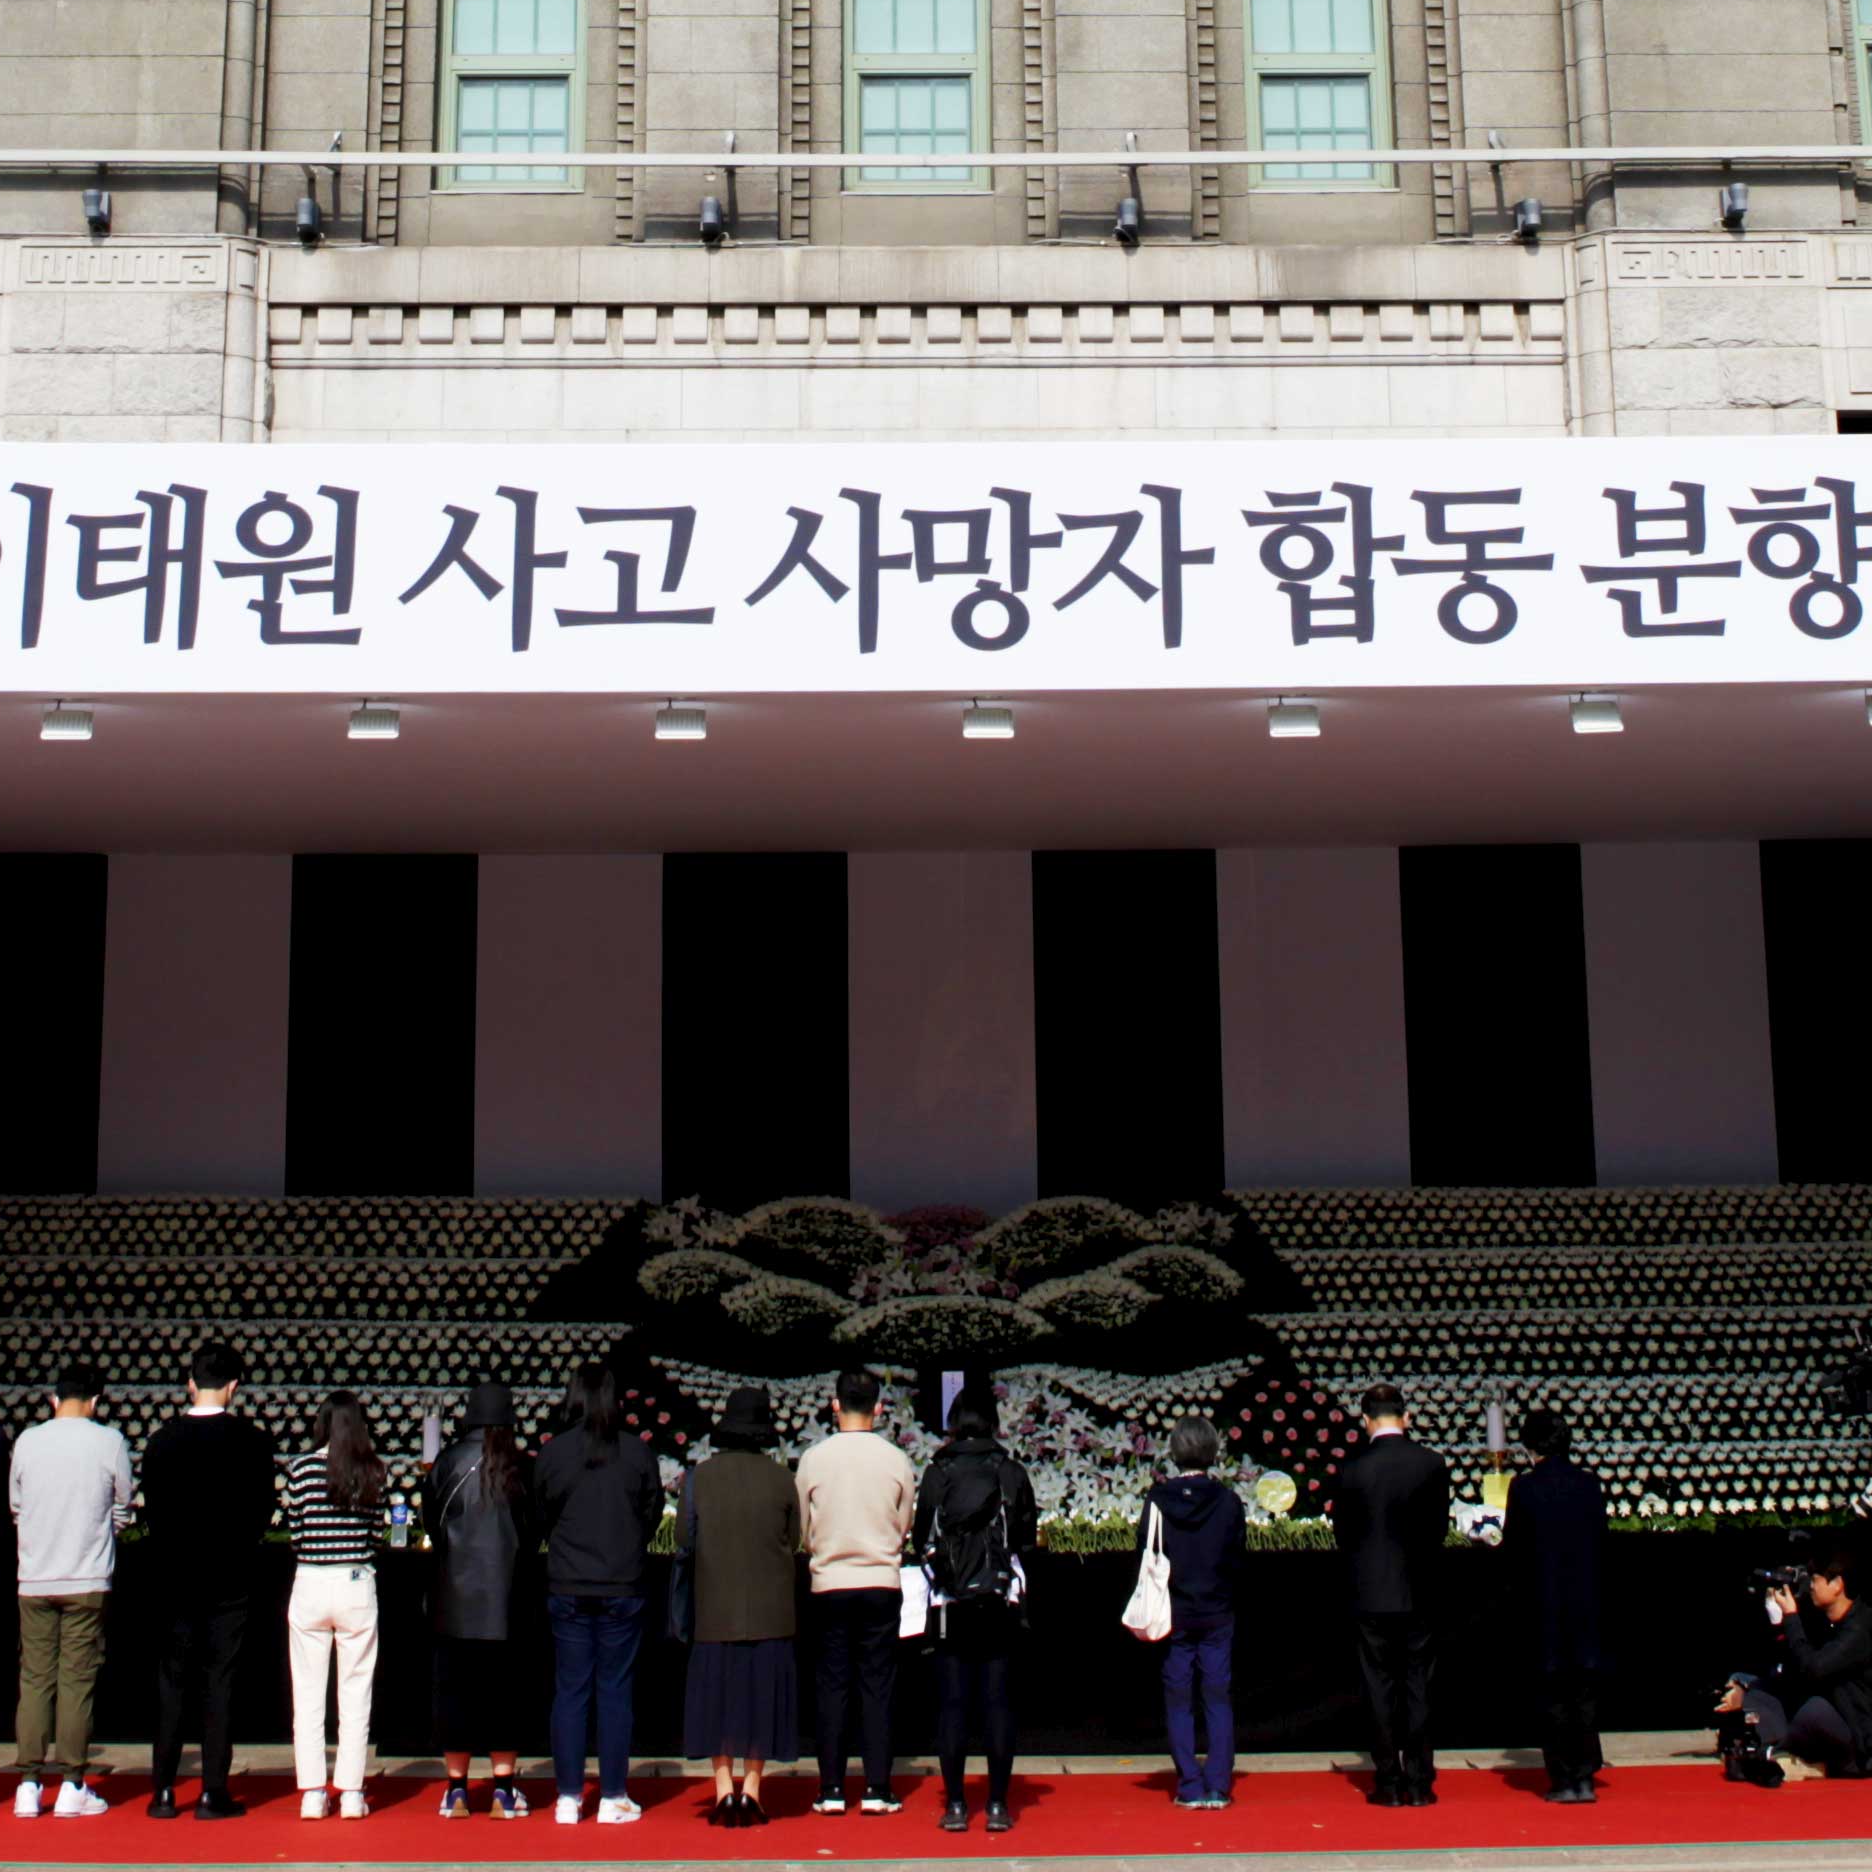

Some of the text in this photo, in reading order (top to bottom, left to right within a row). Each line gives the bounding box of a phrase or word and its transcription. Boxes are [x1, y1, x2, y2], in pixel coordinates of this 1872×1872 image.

[399, 486, 714, 653] 사고
[745, 484, 1214, 653] 사망자
[1242, 483, 1553, 645] 합동
